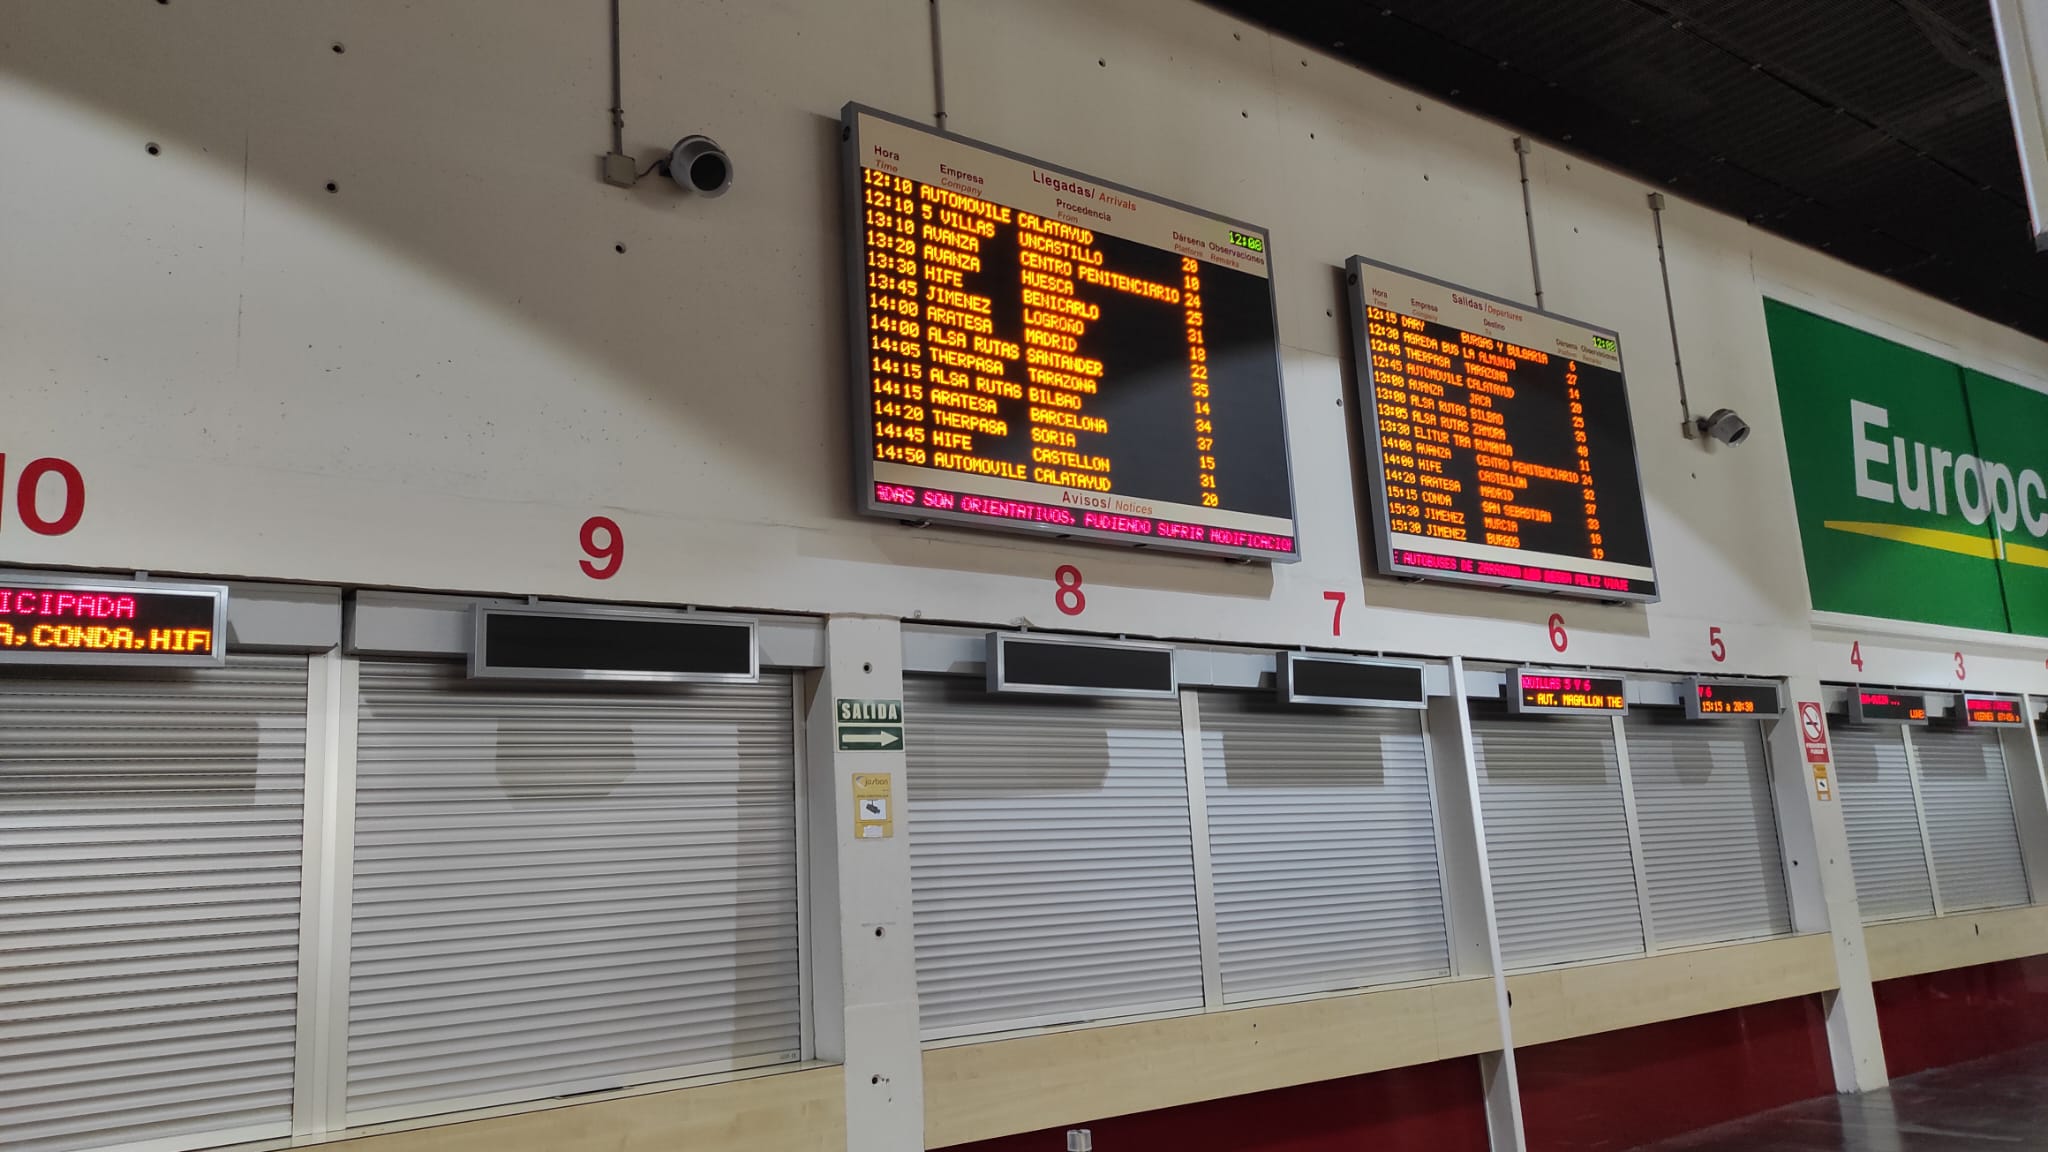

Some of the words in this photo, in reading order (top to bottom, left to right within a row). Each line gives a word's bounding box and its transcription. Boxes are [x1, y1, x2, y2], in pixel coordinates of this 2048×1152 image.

[874, 144, 899, 161] Hora
[939, 163, 984, 187] Empresa
[1056, 197, 1111, 222] Procedencia
[875, 159, 897, 173] Time
[940, 176, 982, 198] Company
[1057, 210, 1078, 223] From
[1098, 191, 1136, 212] Arrivals
[864, 167, 912, 195] 12:10
[920, 183, 1011, 223] AUTOMOVILE
[1017, 211, 1092, 246] CALATAYUD
[1181, 256, 1197, 274] 20
[865, 188, 914, 215] 12:10
[921, 203, 932, 220] 5
[940, 208, 995, 238] VILLAS
[1018, 229, 1102, 266] UNCASTILLO
[1183, 273, 1199, 292] 10
[866, 208, 914, 235] 13:10
[922, 223, 979, 253] AVANZA
[1019, 248, 1071, 277] CENTRO
[1077, 263, 1178, 304] PENITENCIARIO
[1183, 290, 1200, 310] 24
[867, 229, 916, 256] 13:20
[923, 243, 980, 272] AVANZA
[1020, 268, 1072, 296] HUESCA
[1185, 308, 1202, 327] 25
[868, 250, 916, 276] 13:30
[924, 263, 963, 288] HIFE
[1021, 286, 1098, 320] BENICARLO
[1186, 326, 1203, 344] 31
[869, 271, 917, 296] 13:45
[925, 284, 991, 315] JIMENEZ
[1023, 306, 1083, 335] LOGROÑO
[1189, 344, 1205, 362] 18
[1367, 306, 1397, 324] 12:15
[870, 292, 918, 317] 14:00
[926, 304, 992, 334] ARATESA
[1023, 325, 1076, 352] MADRID
[1189, 362, 1207, 380] 22
[871, 313, 920, 338] 14:00
[927, 325, 966, 348] ALSA
[973, 335, 1020, 360] RUTAS
[1025, 346, 1102, 378] SANTANDER
[1191, 381, 1208, 398] 35
[1369, 321, 1399, 340] 12:30
[1402, 330, 1438, 350] AGREDA
[1441, 341, 1459, 356] BUS
[1462, 346, 1475, 360] LA
[1478, 350, 1516, 370] ALMUNIA
[872, 335, 920, 358] 14:05
[929, 346, 1004, 376] THERPASA
[1027, 366, 1095, 394] TARAZONA
[1194, 400, 1210, 415] 14
[1370, 337, 1400, 356] 12:45
[1404, 346, 1450, 368] THERPASA
[1464, 361, 1508, 382] TARAZONA
[1568, 387, 1579, 400] 14
[1372, 354, 1402, 372] 12:45
[1405, 362, 1463, 386] AUTOMOVILE
[1465, 376, 1515, 398] CALATAYUD
[873, 356, 921, 379] 14:15
[929, 367, 969, 388] ALSA
[975, 376, 1022, 399] RUTAS
[1027, 386, 1080, 410] BILBAO
[1195, 417, 1212, 433] 34
[874, 377, 922, 400] 14:15
[930, 387, 997, 414] ARATESA
[1029, 406, 1106, 433] BARCELONA
[1196, 436, 1213, 452] 37
[1374, 370, 1404, 388] 13:00
[1408, 378, 1444, 396] AVANZA
[1468, 392, 1491, 407] JACA
[1572, 415, 1584, 428] 25
[1376, 386, 1406, 403] 13:00
[1409, 393, 1434, 410] ALSA
[1438, 400, 1467, 417] RUTAS
[1469, 407, 1503, 425] BILBAO
[875, 399, 923, 421] 14:20
[932, 409, 1007, 436] THERPASA
[1030, 426, 1075, 447] SORIA
[1199, 454, 1215, 470] 15
[1378, 402, 1408, 420] 13:05
[1411, 409, 1436, 426] ALSA
[1440, 415, 1469, 433] RUTAS
[1472, 422, 1506, 440] ZAMORA
[1380, 418, 1410, 435] 13:30
[1413, 425, 1449, 443] ELITUR
[1473, 437, 1513, 457] RUMANIA
[1579, 459, 1589, 471] 11
[876, 421, 924, 443] 14:45
[932, 430, 972, 450] HIFE
[1031, 446, 1109, 472] CASTELLON
[1199, 473, 1215, 488] 31
[876, 442, 926, 464] 14:50
[933, 451, 1026, 479] AUTOMOVILE
[1033, 466, 1110, 491] CALATAYUD
[1202, 491, 1218, 506] 20
[1382, 435, 1412, 451] 14:00
[1415, 442, 1451, 459] AVANZA
[1475, 453, 1510, 471] CENTRO
[1512, 460, 1579, 483] PENITENCIARIO
[1581, 474, 1592, 486] 24
[1383, 452, 1414, 468] 14:00
[1417, 458, 1442, 473] HIFE
[1850, 398, 2048, 559] Europc
[922, 489, 954, 509] SON
[960, 495, 1075, 525] ORIENTATIVOS,
[1083, 511, 1151, 534] PUDIENDO
[1156, 522, 1204, 540] SUFRIR
[1114, 499, 1152, 514] Notices
[1385, 468, 1416, 484] 14:20
[1419, 474, 1461, 492] ARATESA
[1479, 484, 1514, 501] MADRID
[1585, 503, 1596, 515] 37
[1387, 485, 1417, 500] 15:15
[1421, 490, 1452, 506] CONDA
[1481, 500, 1500, 514] SAN
[578, 516, 625, 579] 9
[1389, 502, 1419, 517] 15:30
[1424, 507, 1464, 524] JIMENEZ
[1483, 516, 1518, 532] MURCIA
[1590, 532, 1601, 544] 18
[1391, 518, 1421, 533] 15:30
[1426, 523, 1466, 540] JIMENEZ
[1485, 532, 1520, 548] BURGOS
[1592, 547, 1603, 559] 19
[1055, 565, 1086, 615] 8
[1461, 560, 1473, 573] DE
[1322, 590, 1347, 637] 7
[1549, 613, 1568, 652] 6
[1709, 626, 1726, 662] 5
[1850, 640, 1863, 672] 4
[1954, 652, 1966, 680] 3
[841, 702, 898, 720] SALIDA
[1563, 694, 1603, 707] MAGALLON
